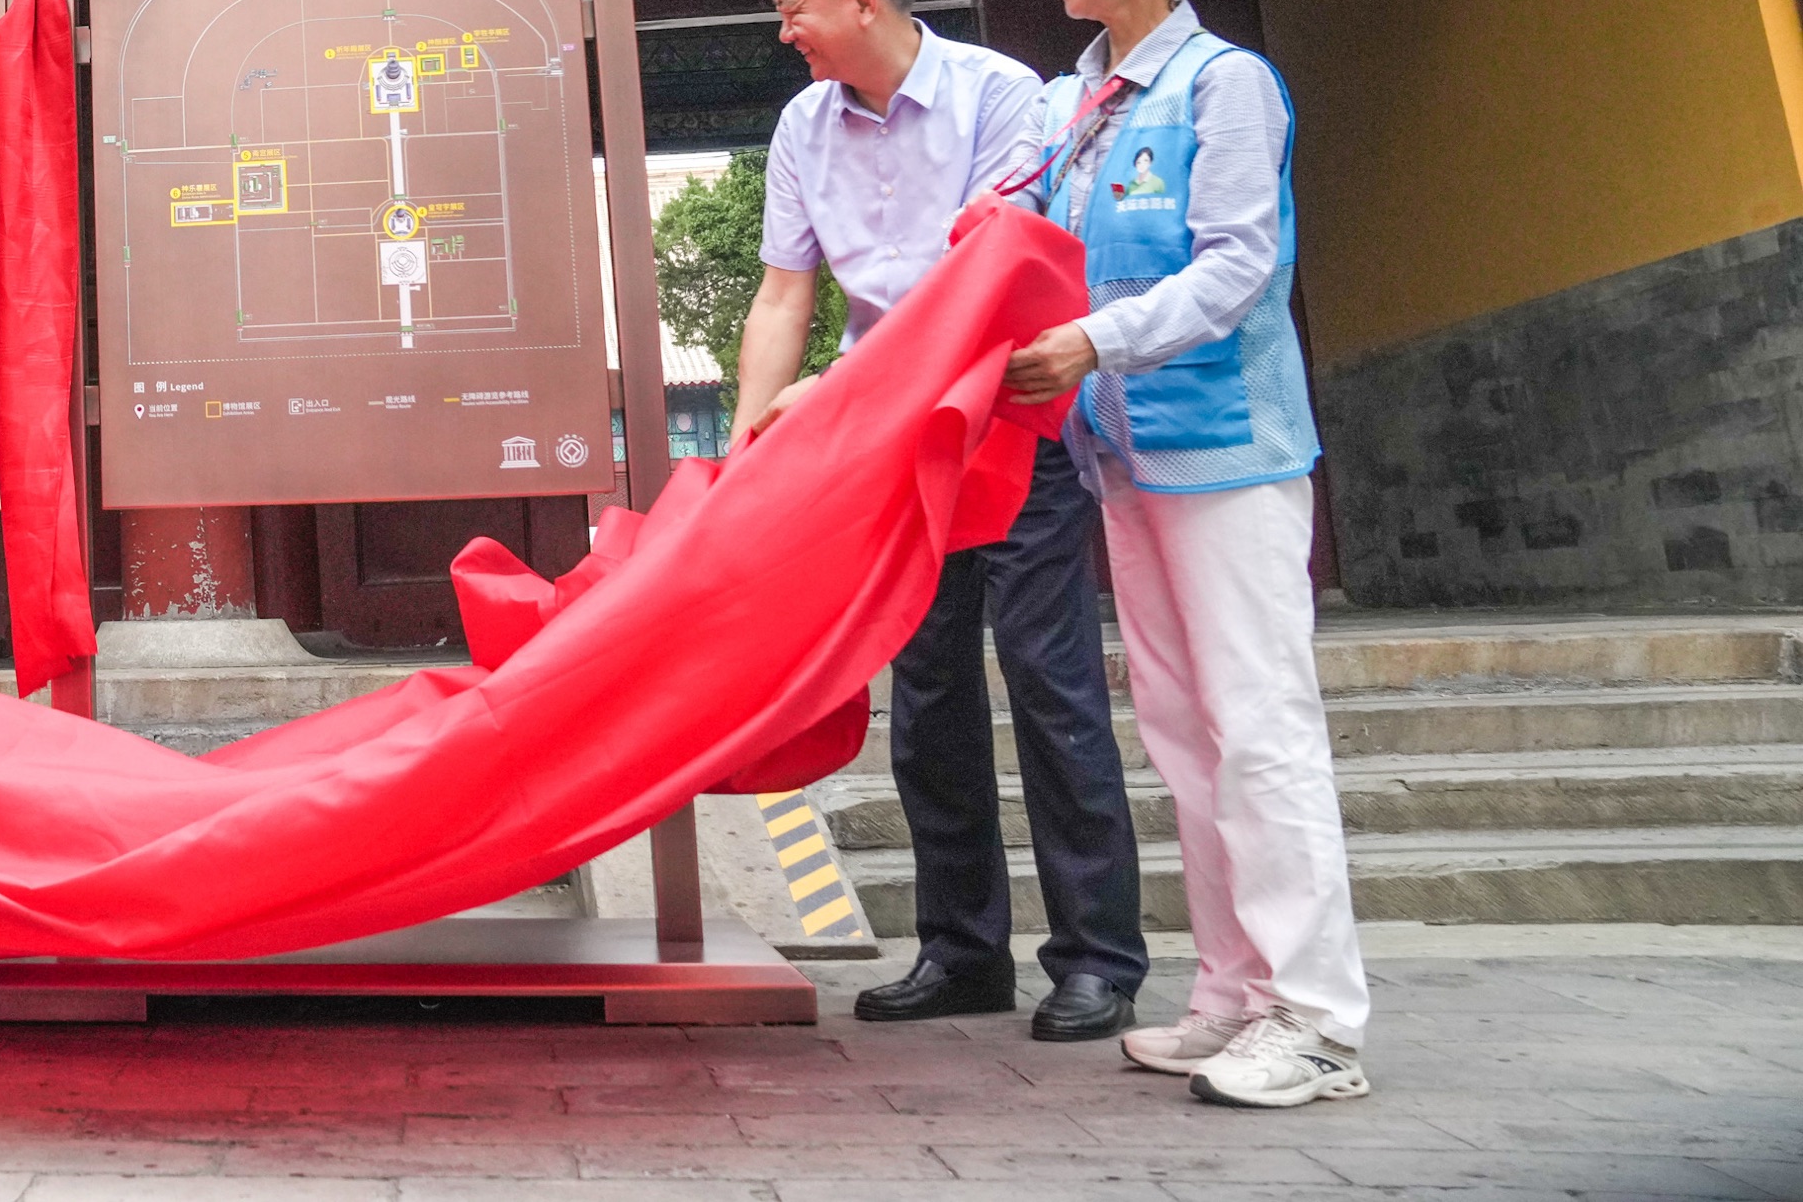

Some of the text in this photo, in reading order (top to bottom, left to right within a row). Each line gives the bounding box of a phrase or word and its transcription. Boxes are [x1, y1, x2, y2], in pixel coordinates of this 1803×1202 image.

[170, 382, 204, 393] Legend
[306, 399, 329, 407] 出入口
